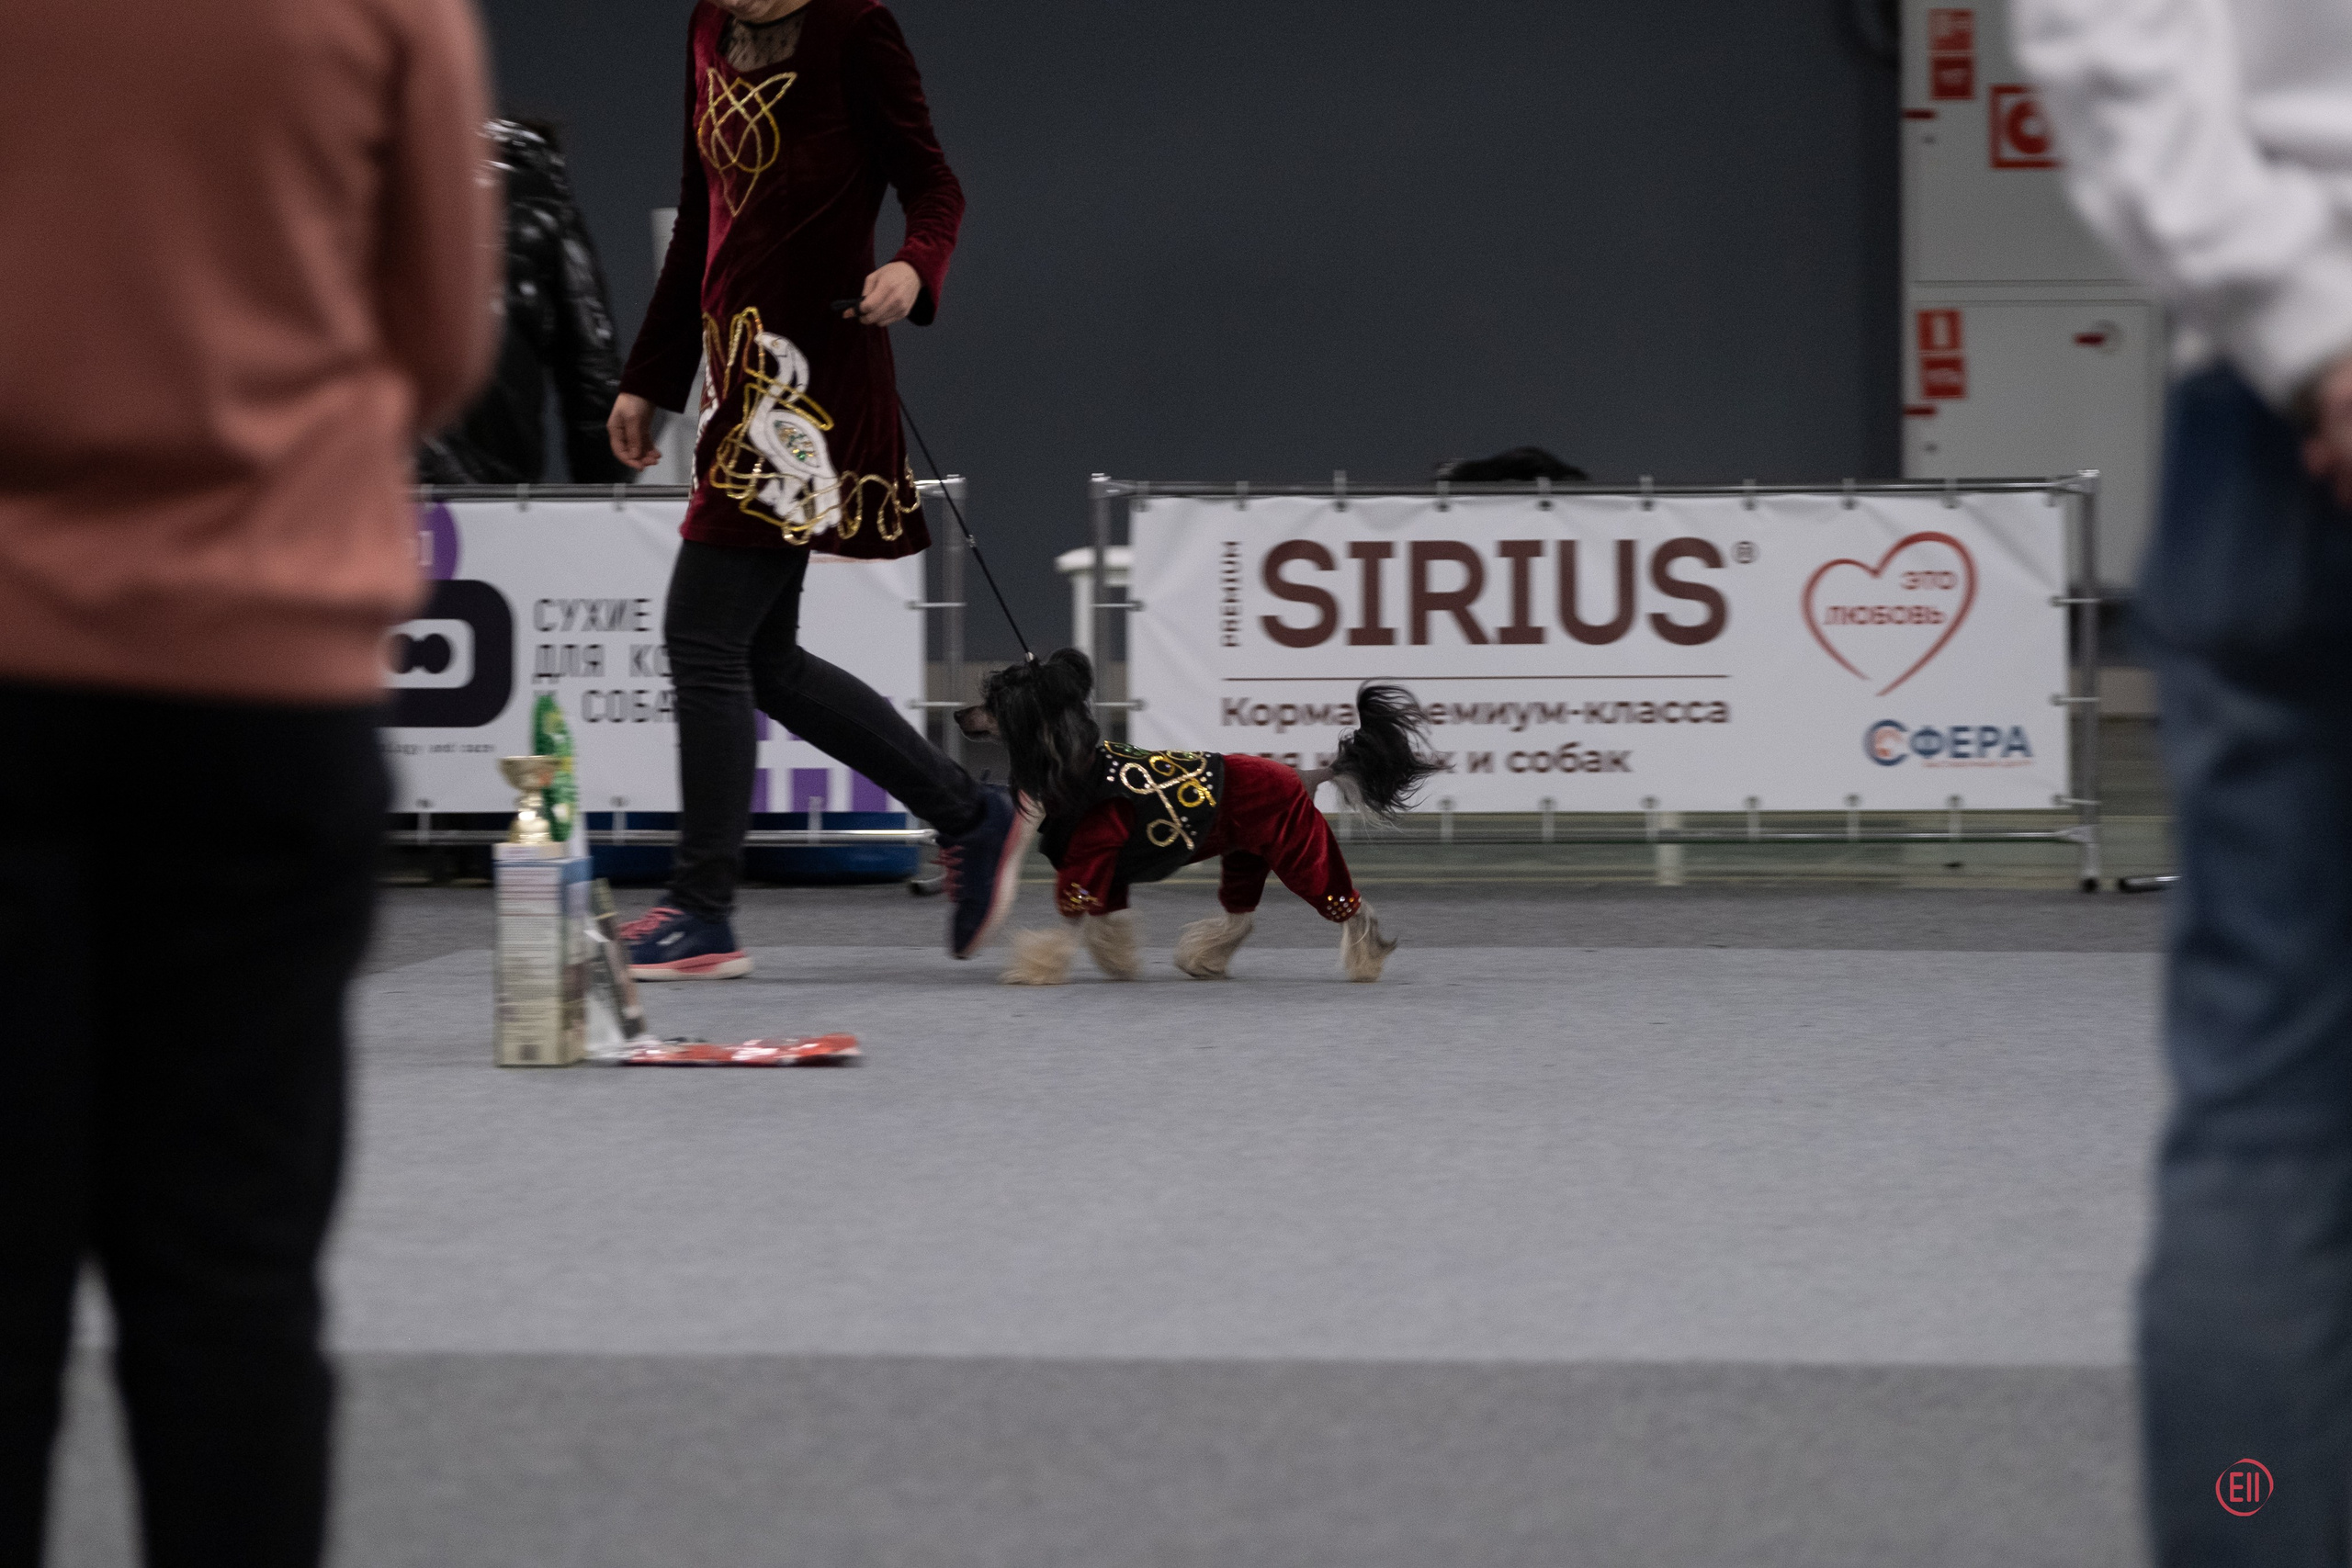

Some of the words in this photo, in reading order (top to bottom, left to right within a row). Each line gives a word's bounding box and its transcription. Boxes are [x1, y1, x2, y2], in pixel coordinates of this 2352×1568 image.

[533, 598, 650, 632] СУХИЕ
[1824, 605, 1946, 626] ЛЮБОВЬ
[532, 644, 605, 684] ДЛЯ
[1221, 698, 1359, 733] Корма
[1415, 701, 1730, 732] емиум-класса
[1468, 750, 1493, 773] и
[1508, 741, 1632, 773] собак
[1863, 719, 2033, 766] СФЕРА
